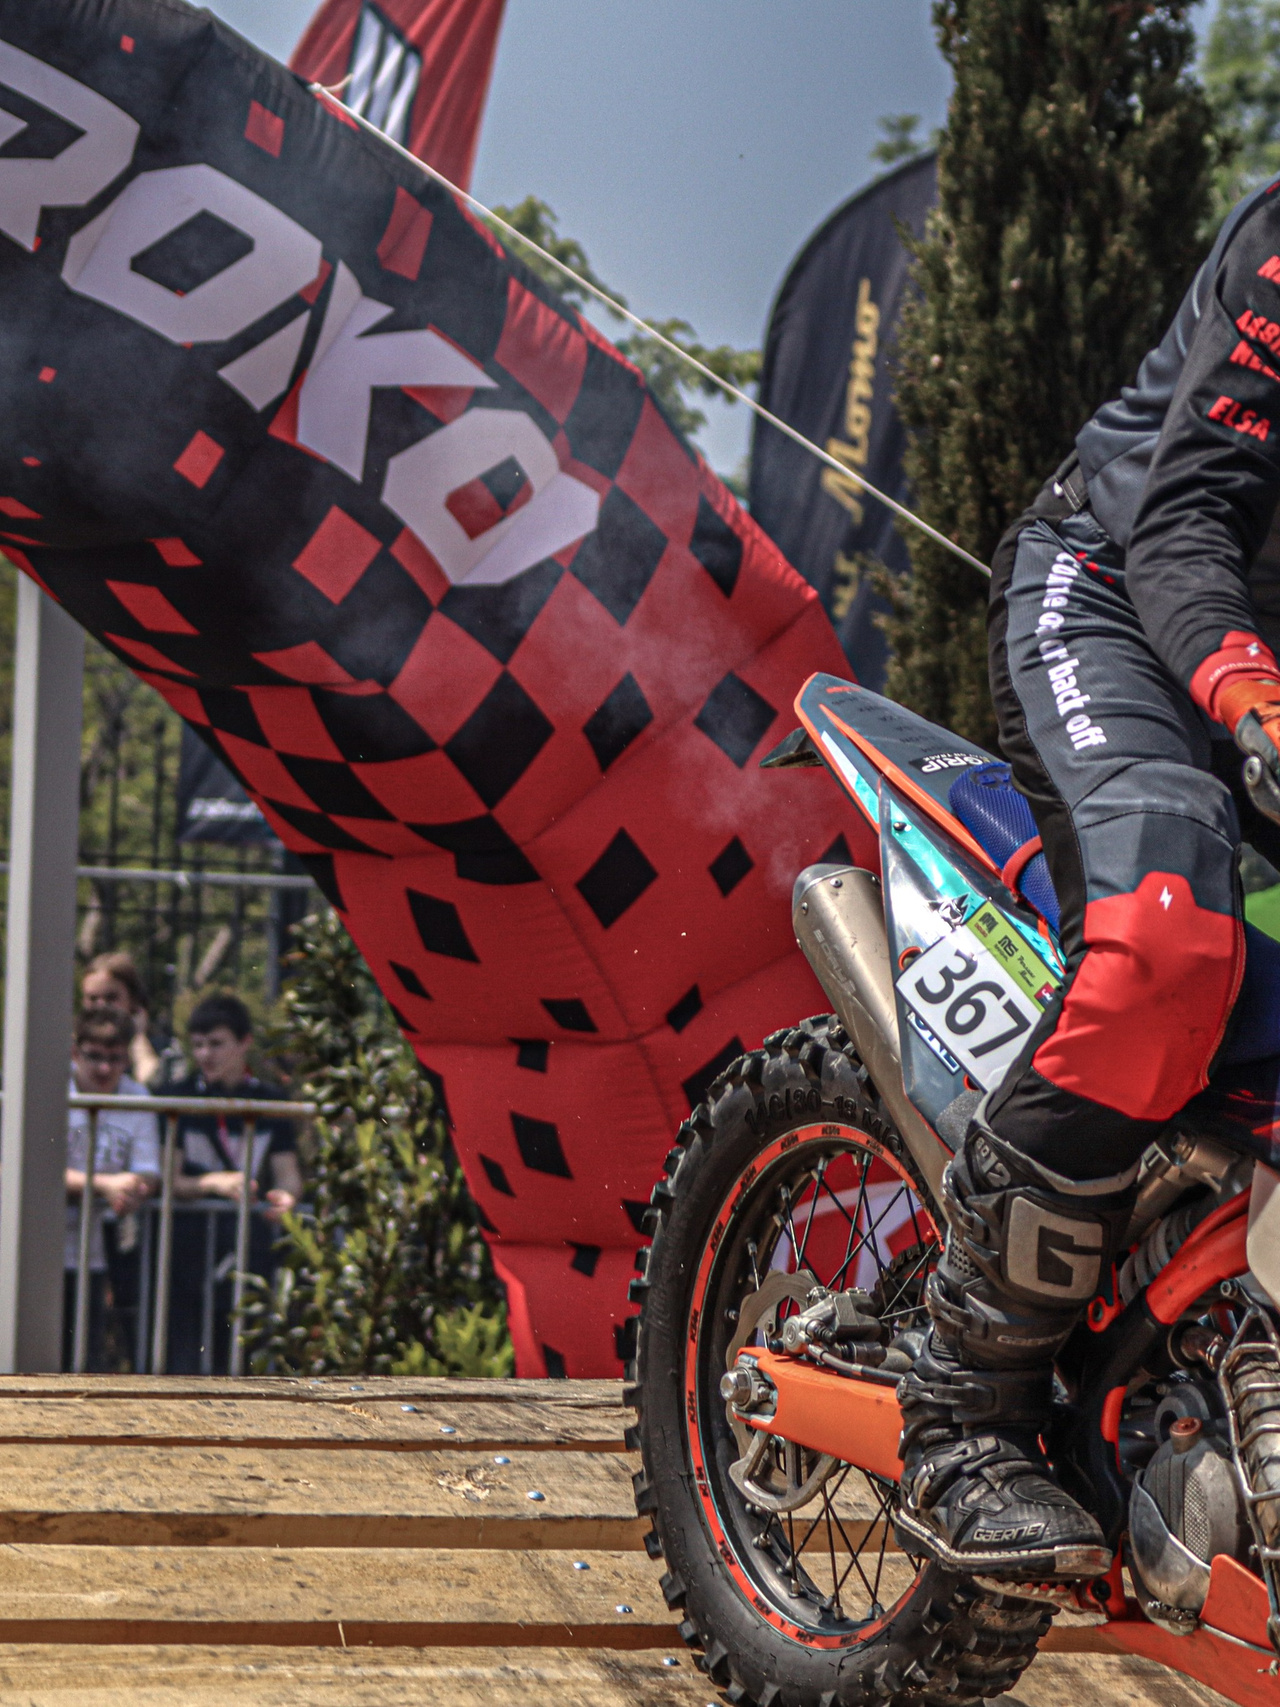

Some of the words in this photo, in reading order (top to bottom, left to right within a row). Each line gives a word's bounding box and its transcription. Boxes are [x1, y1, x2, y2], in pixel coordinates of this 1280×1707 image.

[0, 40, 600, 587] ROKO
[1207, 395, 1272, 442] ELSA
[1048, 657, 1091, 717] back
[1066, 714, 1107, 751] off
[914, 948, 1032, 1058] 367
[689, 1309, 700, 1343] KTM
[687, 1389, 697, 1423] KTM
